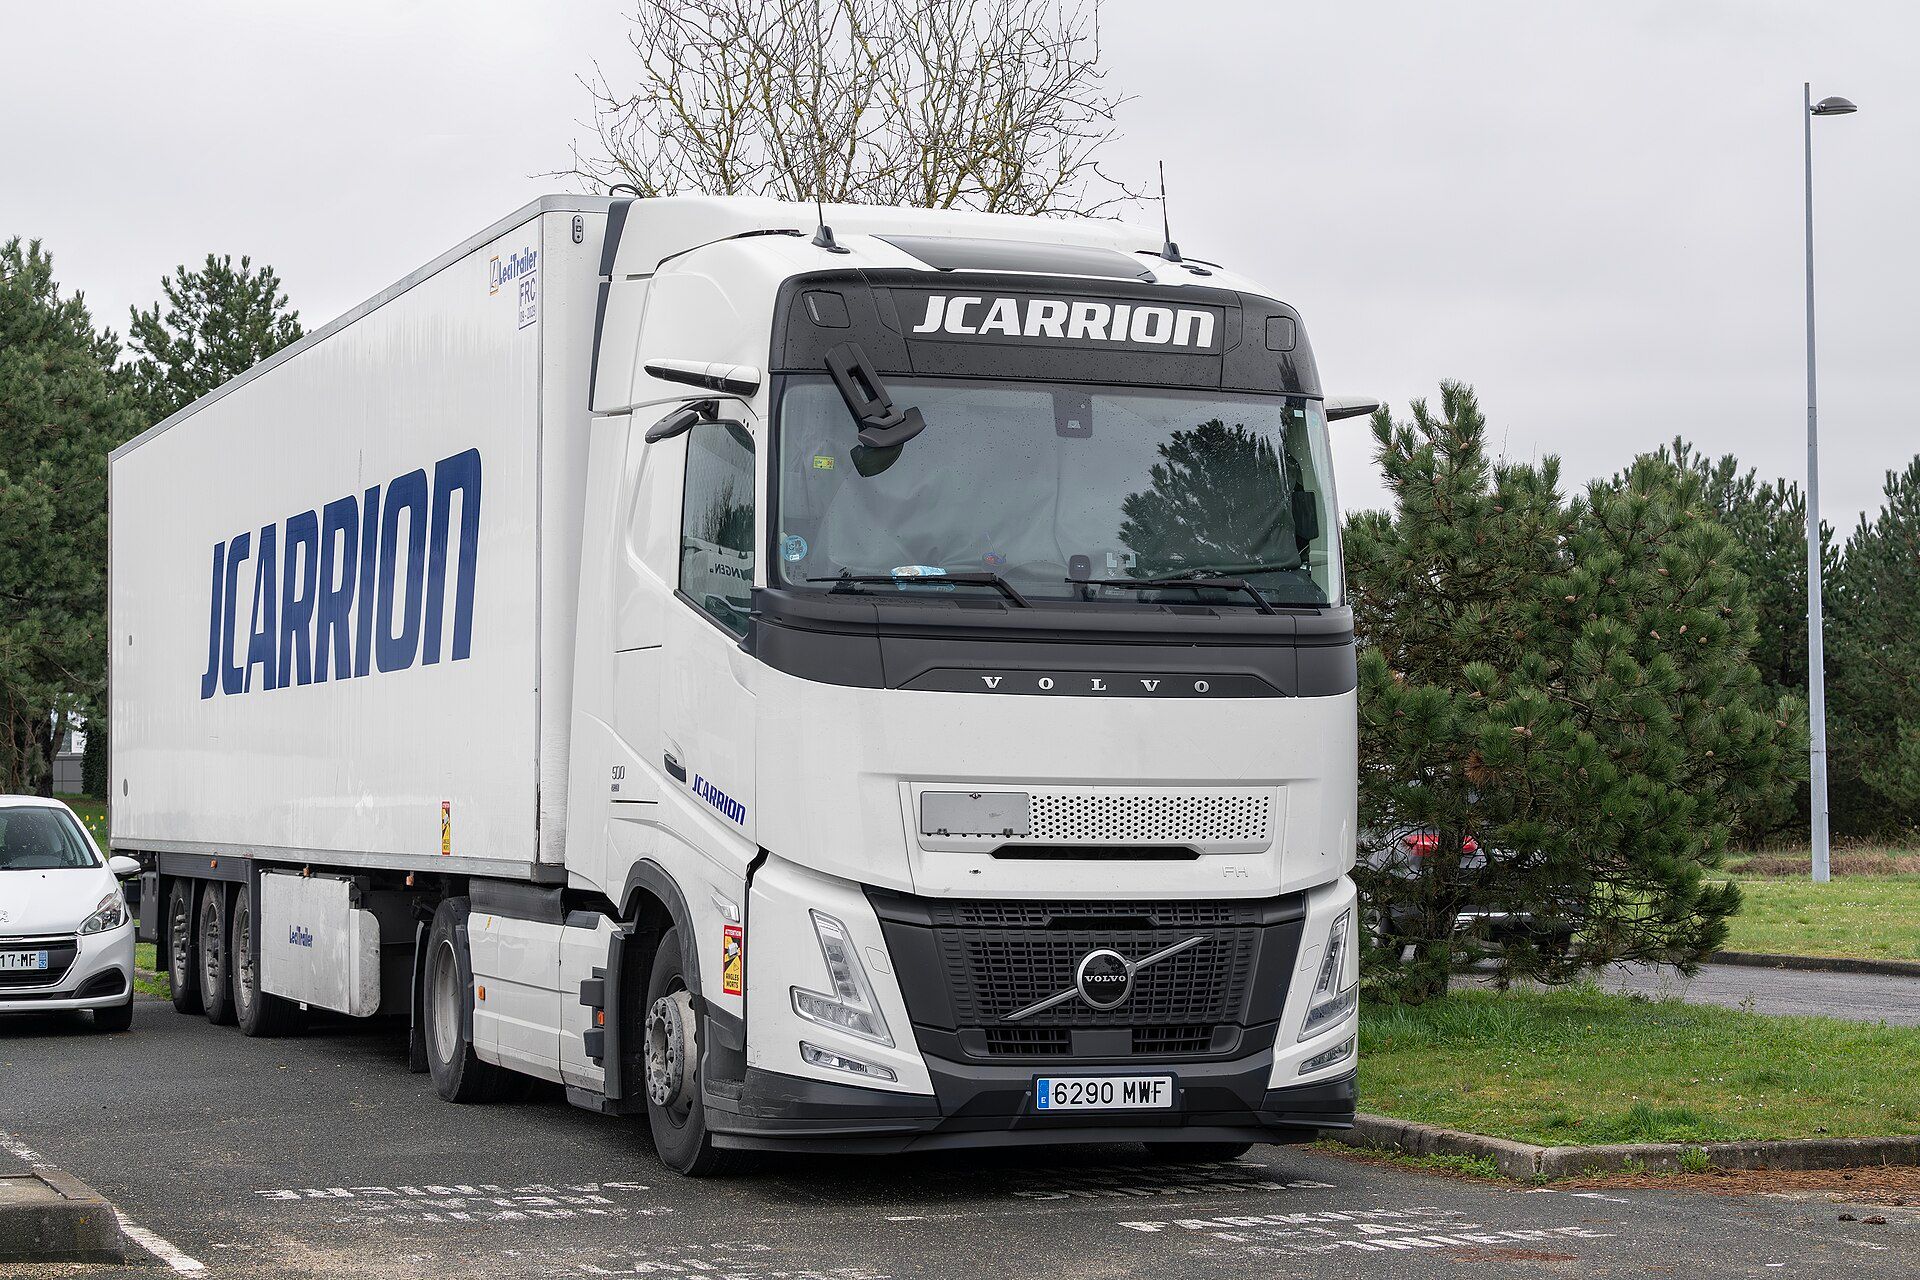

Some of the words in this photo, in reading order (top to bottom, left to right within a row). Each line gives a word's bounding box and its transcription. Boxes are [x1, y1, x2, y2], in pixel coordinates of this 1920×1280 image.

[520, 277, 536, 306] FRC
[913, 295, 1215, 348] JCARRION
[200, 447, 482, 700] JCARRION
[981, 676, 1210, 693] VOLVO
[612, 765, 625, 780] 500
[692, 773, 746, 826] JCARRION
[1222, 865, 1248, 877] FH
[1054, 1081, 1114, 1105] 6290
[1123, 1081, 1166, 1104] MWF
